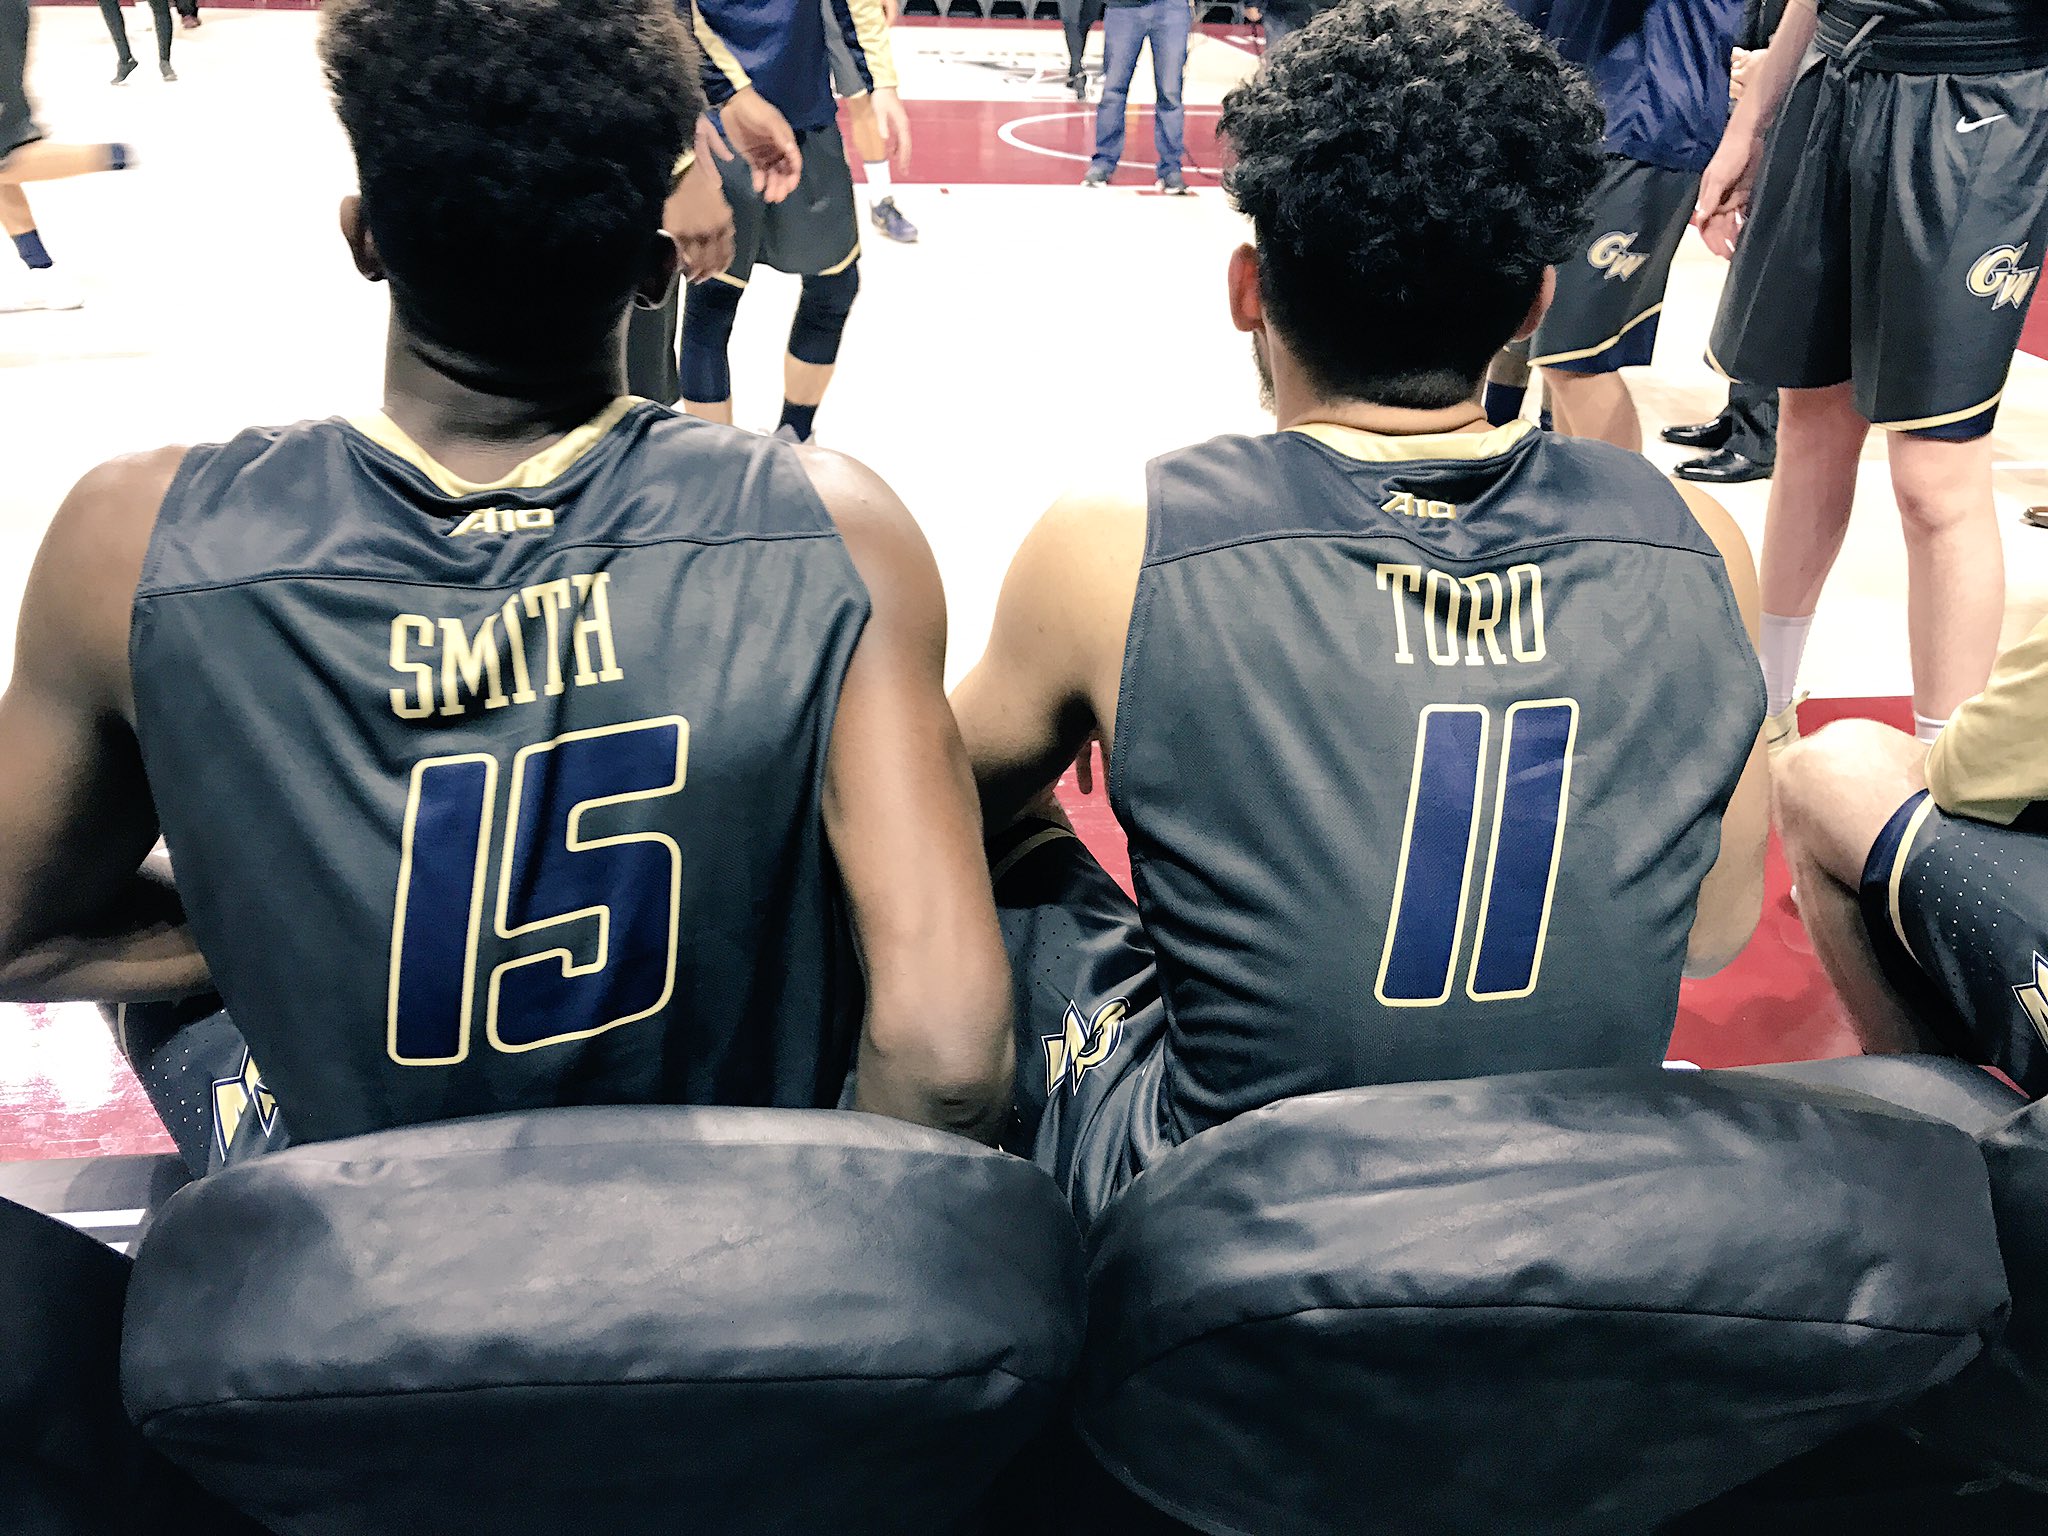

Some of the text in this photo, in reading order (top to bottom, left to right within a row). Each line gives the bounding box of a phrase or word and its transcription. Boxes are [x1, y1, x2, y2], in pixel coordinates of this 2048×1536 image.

[1966, 241, 2040, 311] GW
[389, 571, 624, 719] SMITH
[1376, 563, 1547, 666] TORO
[387, 714, 690, 1066] 15
[1373, 697, 1580, 1007] 11
